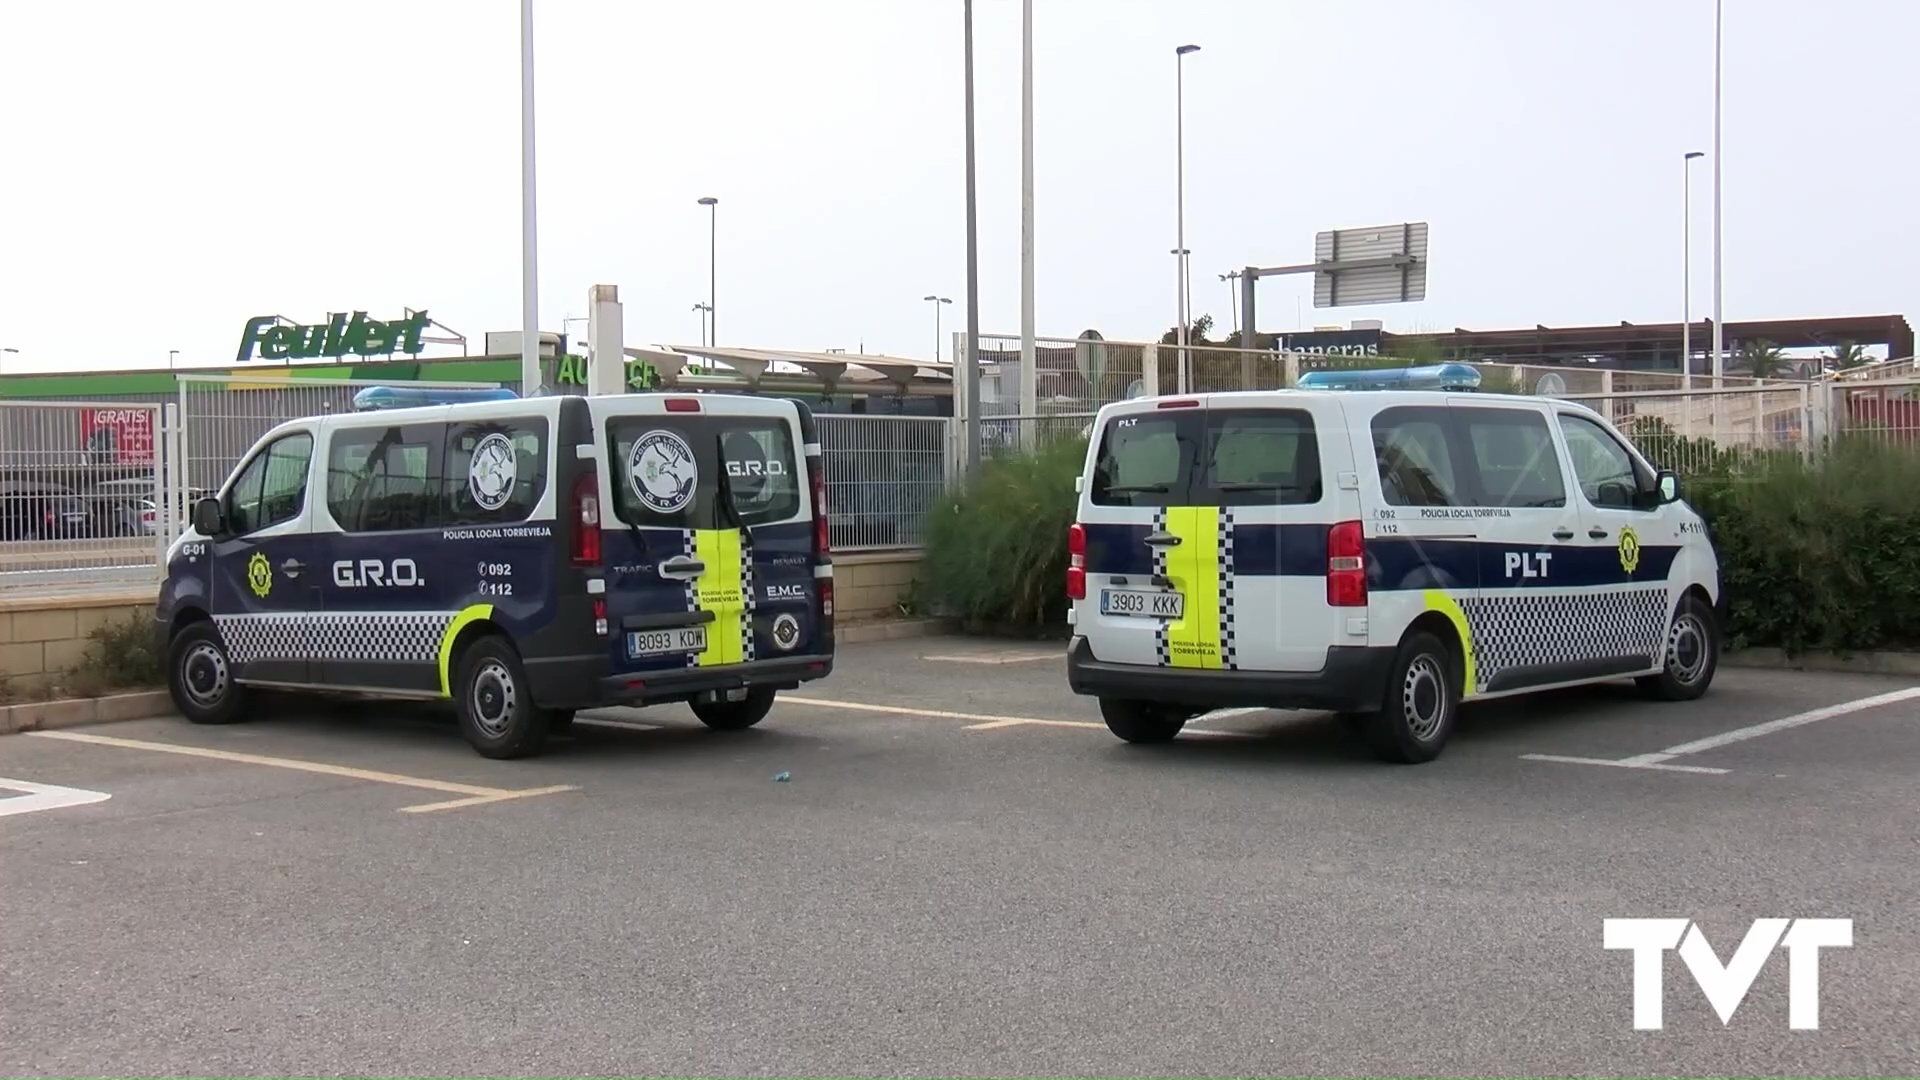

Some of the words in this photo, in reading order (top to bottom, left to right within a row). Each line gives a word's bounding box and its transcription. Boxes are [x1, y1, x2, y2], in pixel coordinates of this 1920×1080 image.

[1118, 418, 1138, 428] PLT
[635, 436, 661, 462] POLICIA
[662, 437, 687, 459] LOCAL
[725, 460, 787, 476] G.R.O.
[1380, 509, 1395, 519] 092
[1420, 509, 1450, 518] POLICIA
[1450, 509, 1473, 518] LOCAL
[1473, 509, 1511, 518] TORREVIEJA
[443, 530, 474, 540] POLICIA
[475, 529, 502, 538] LOCAL
[502, 527, 551, 537] TORREVIEJA
[1382, 524, 1398, 534] 112
[183, 544, 205, 555] G-01
[489, 563, 512, 576] 092
[613, 564, 652, 574] TRAFIC
[1504, 552, 1552, 578] PLT
[332, 558, 425, 587] G.R.O.
[489, 583, 512, 595] 112
[766, 585, 805, 597] E.M.C.
[1112, 594, 1144, 611] 3903
[1153, 596, 1178, 614] KKK
[638, 632, 671, 650] 8093
[680, 630, 703, 647] KDW
[1173, 648, 1216, 656] TORREVIEJA
